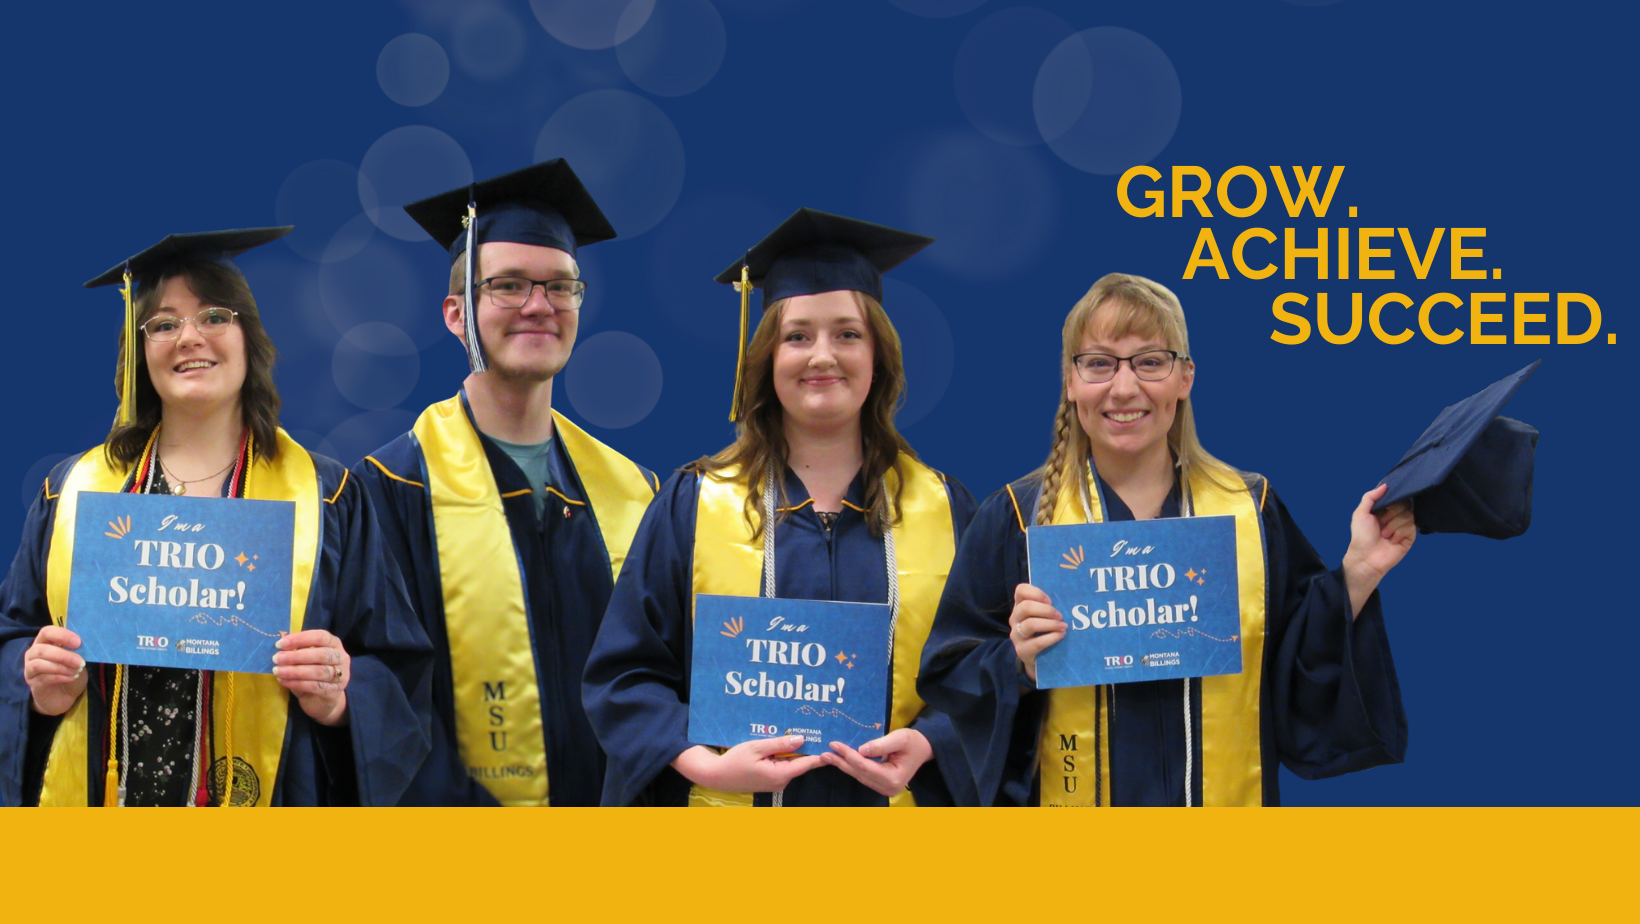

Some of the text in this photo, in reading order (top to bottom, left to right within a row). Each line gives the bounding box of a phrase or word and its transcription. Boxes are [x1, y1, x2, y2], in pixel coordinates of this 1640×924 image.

[157, 514, 205, 532] I'm a
[133, 539, 225, 571] TRIO
[1110, 539, 1155, 558] I'm a
[1089, 562, 1176, 593] TRIO
[108, 575, 246, 611] Scholar!
[1071, 595, 1199, 631] Scholar!
[766, 616, 809, 632] I'm a
[137, 635, 169, 647] TRIO
[186, 638, 220, 647] MONTANA
[185, 647, 220, 655] BILLINGS
[746, 638, 826, 667] TRIO
[1149, 651, 1180, 660] MONTANA
[1103, 655, 1134, 666] TRIO
[1149, 659, 1180, 667] BILLINGS
[724, 671, 846, 704] Scholar!
[750, 723, 778, 734] TRIO
[792, 727, 822, 735] MONTANA
[469, 766, 534, 778] BILLINGS
